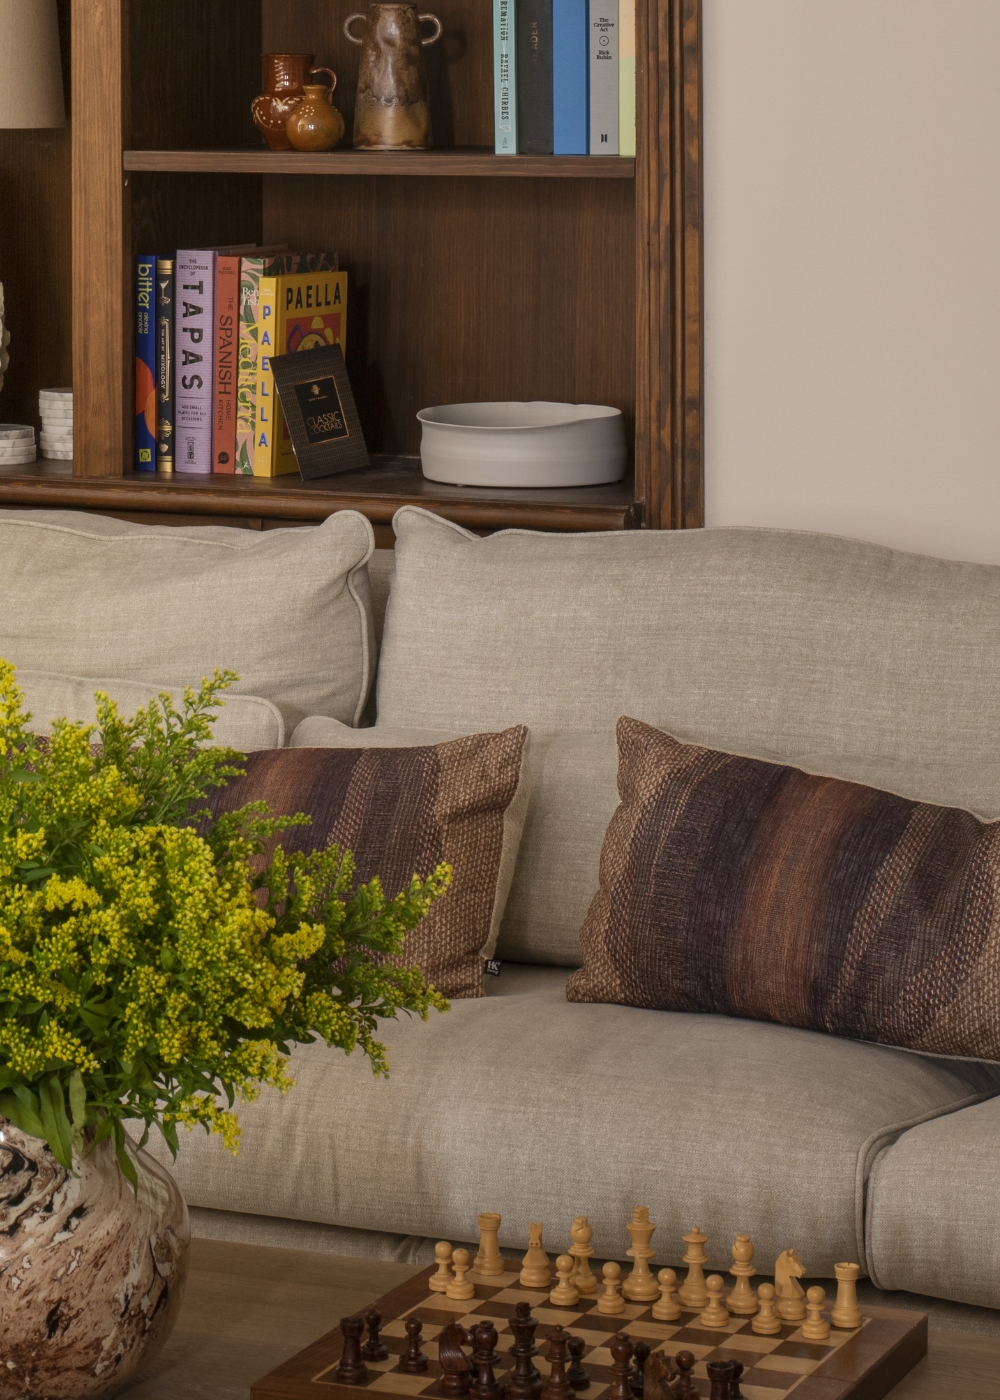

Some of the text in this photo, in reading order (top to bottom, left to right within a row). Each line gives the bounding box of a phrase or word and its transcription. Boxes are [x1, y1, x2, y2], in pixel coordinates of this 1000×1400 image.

[530, 21, 538, 62] READER
[501, 86, 509, 119] CHIRBES
[138, 263, 152, 308] bitter
[241, 296, 259, 305] Tish
[242, 287, 259, 296] Ben
[286, 282, 341, 310] PAELLA
[182, 280, 204, 389] TAPAS
[218, 314, 232, 394] SPANISH
[238, 321, 258, 433] Mediterra
[259, 305, 271, 447] PAELLA
[306, 411, 338, 427] CLASSIC
[308, 420, 342, 434] COCKTAILS
